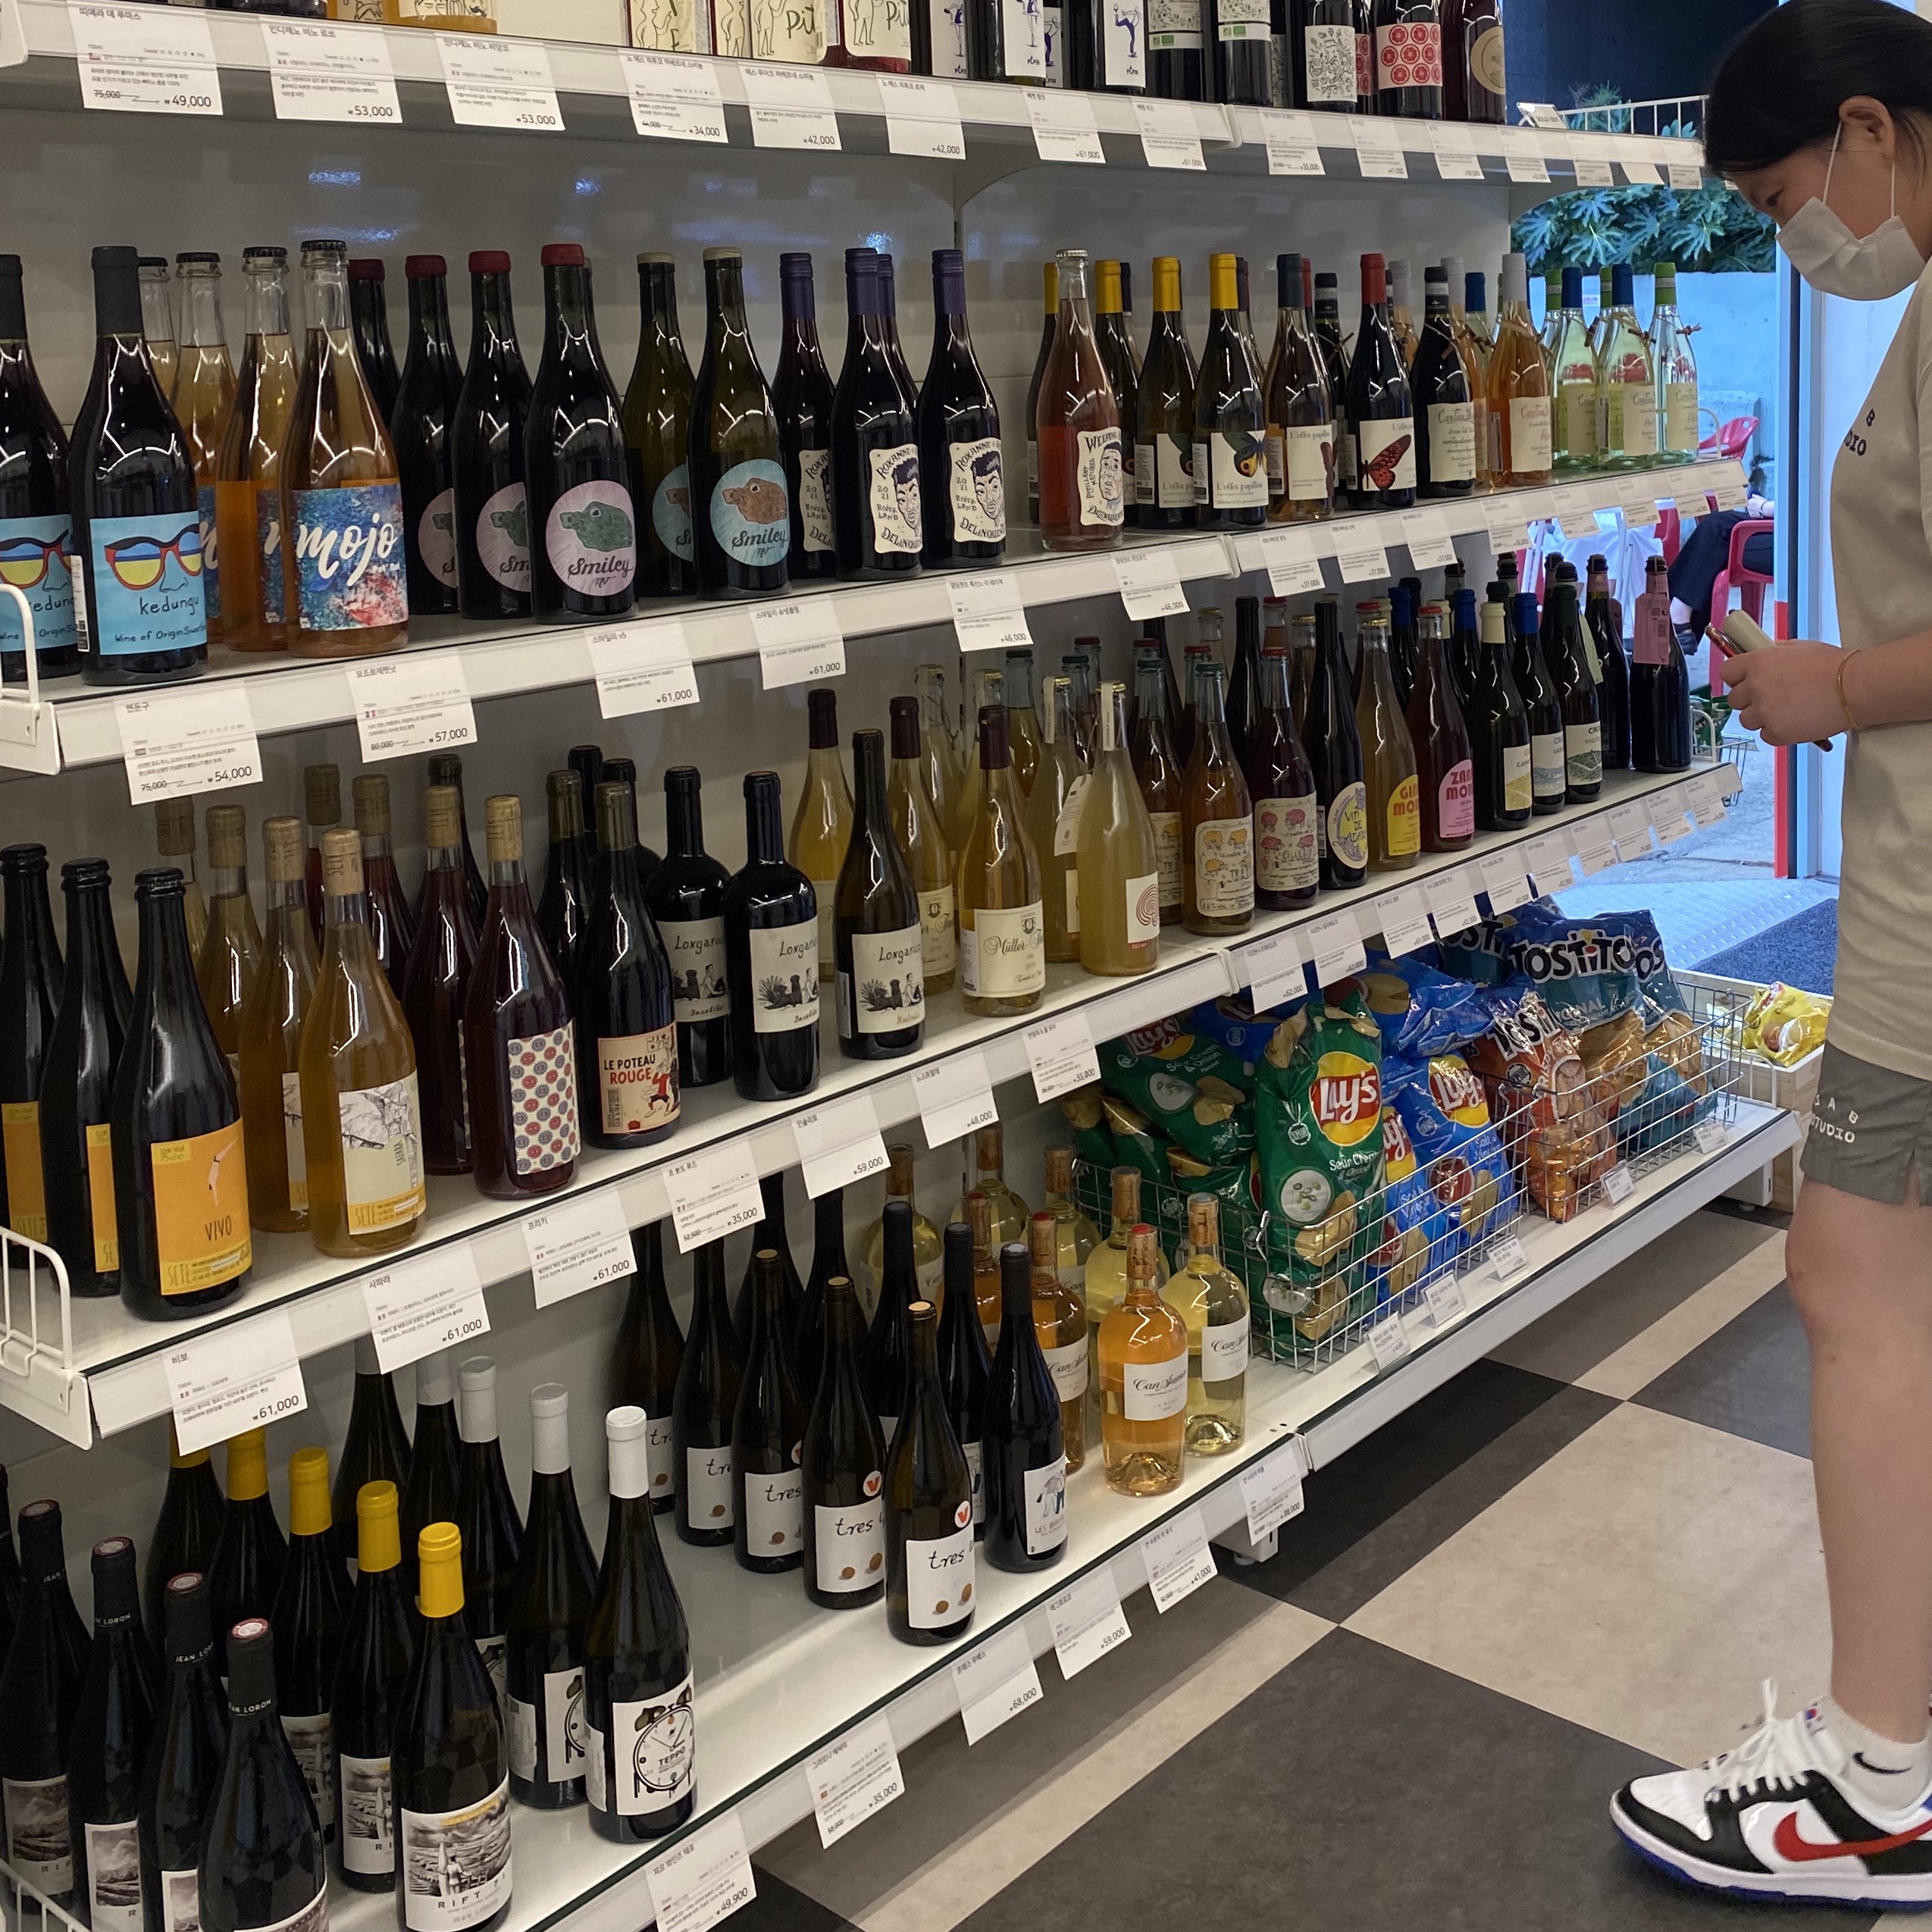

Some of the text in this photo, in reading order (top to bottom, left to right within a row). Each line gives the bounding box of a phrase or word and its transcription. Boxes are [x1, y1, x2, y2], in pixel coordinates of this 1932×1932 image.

[164, 95, 212, 108] ₩49,000
[348, 105, 393, 117] ₩53,000
[878, 484, 888, 493] 20
[957, 477, 967, 485] 20
[731, 529, 790, 548] Smiley
[296, 512, 399, 587] mojo
[568, 556, 634, 577] Smiley
[139, 594, 200, 617] kedungu
[114, 632, 136, 643] Wine
[140, 631, 152, 642] of
[809, 662, 841, 676] ₩61,000
[656, 689, 693, 705] ₩61,000
[428, 727, 468, 744] ₩57,000
[207, 766, 252, 784] ₩54,000
[1774, 996, 1798, 1016] Classic
[604, 1053, 656, 1072] LE POTEAU
[610, 1067, 653, 1085] ROUGE
[1320, 1070, 1377, 1125] Lay's
[966, 1110, 993, 1127] ₩48,000
[853, 1156, 884, 1175] ₩59,000
[1329, 1157, 1351, 1173] Sour
[355, 1207, 376, 1227] SETE
[727, 1207, 757, 1226] ₩35,000
[204, 1214, 233, 1242] VIVO
[168, 1262, 193, 1286] SETE
[593, 1259, 630, 1281] ₩61,000
[442, 1318, 483, 1342] ₩61,000
[1211, 1339, 1234, 1353] Can
[1133, 1377, 1160, 1392] Can
[252, 1394, 300, 1422] ₩61,000
[835, 1516, 875, 1537] tres
[928, 1548, 965, 1570] tres
[103, 1612, 131, 1626] LORON
[1100, 1627, 1125, 1649] ₩59,000
[175, 1653, 196, 1663] JEAN
[243, 1698, 271, 1714] LORON
[658, 1745, 687, 1768] TEPPO
[868, 1782, 897, 1808] ₩35,000
[437, 1890, 481, 1909] RIFT
[715, 1887, 749, 1916] ₩49,900
